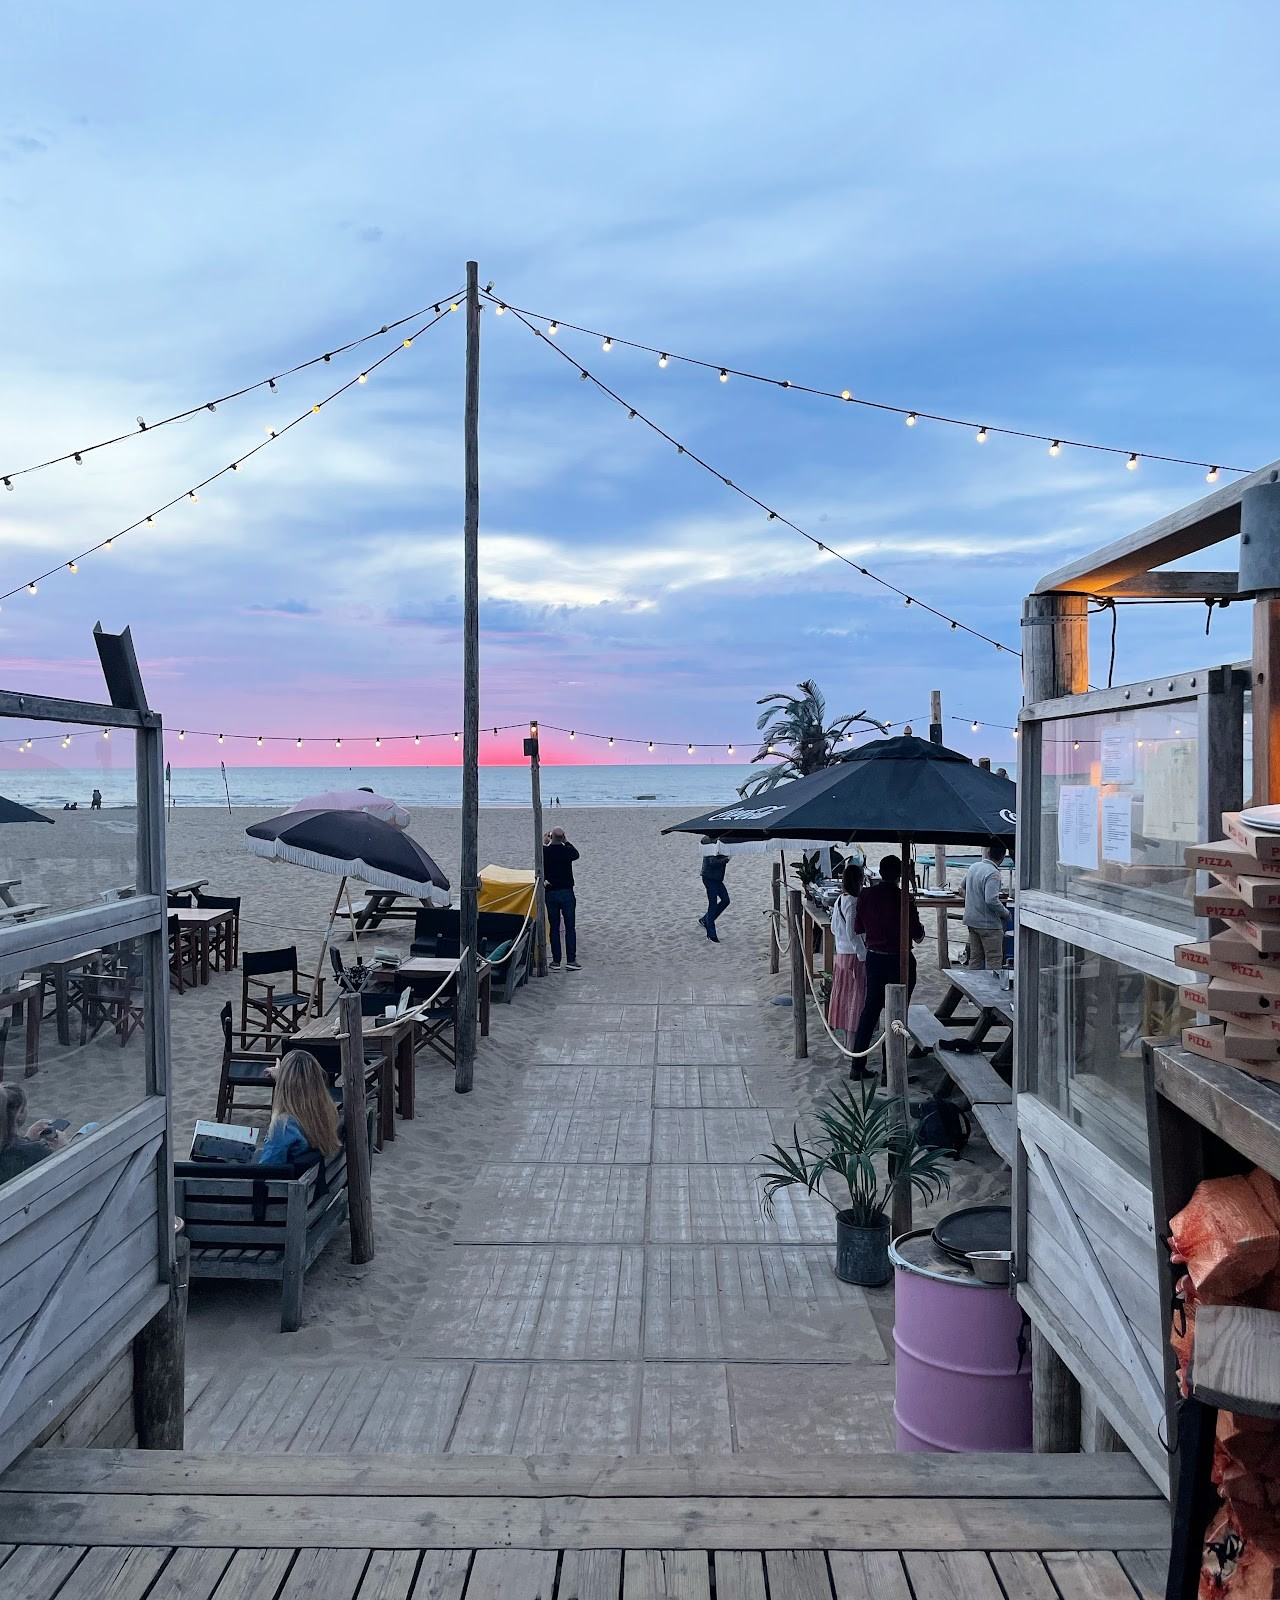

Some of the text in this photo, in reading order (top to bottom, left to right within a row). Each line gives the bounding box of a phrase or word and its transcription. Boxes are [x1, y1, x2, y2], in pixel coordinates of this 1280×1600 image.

[1197, 856, 1232, 868] PIZZA
[1262, 863, 1280, 873] PIZ
[1206, 906, 1247, 917] PIZZA
[1181, 951, 1209, 965] PIZZA
[1231, 963, 1263, 979] PIZZA
[1184, 990, 1207, 1005] PIZZA
[1187, 1033, 1212, 1049] PIZZA
